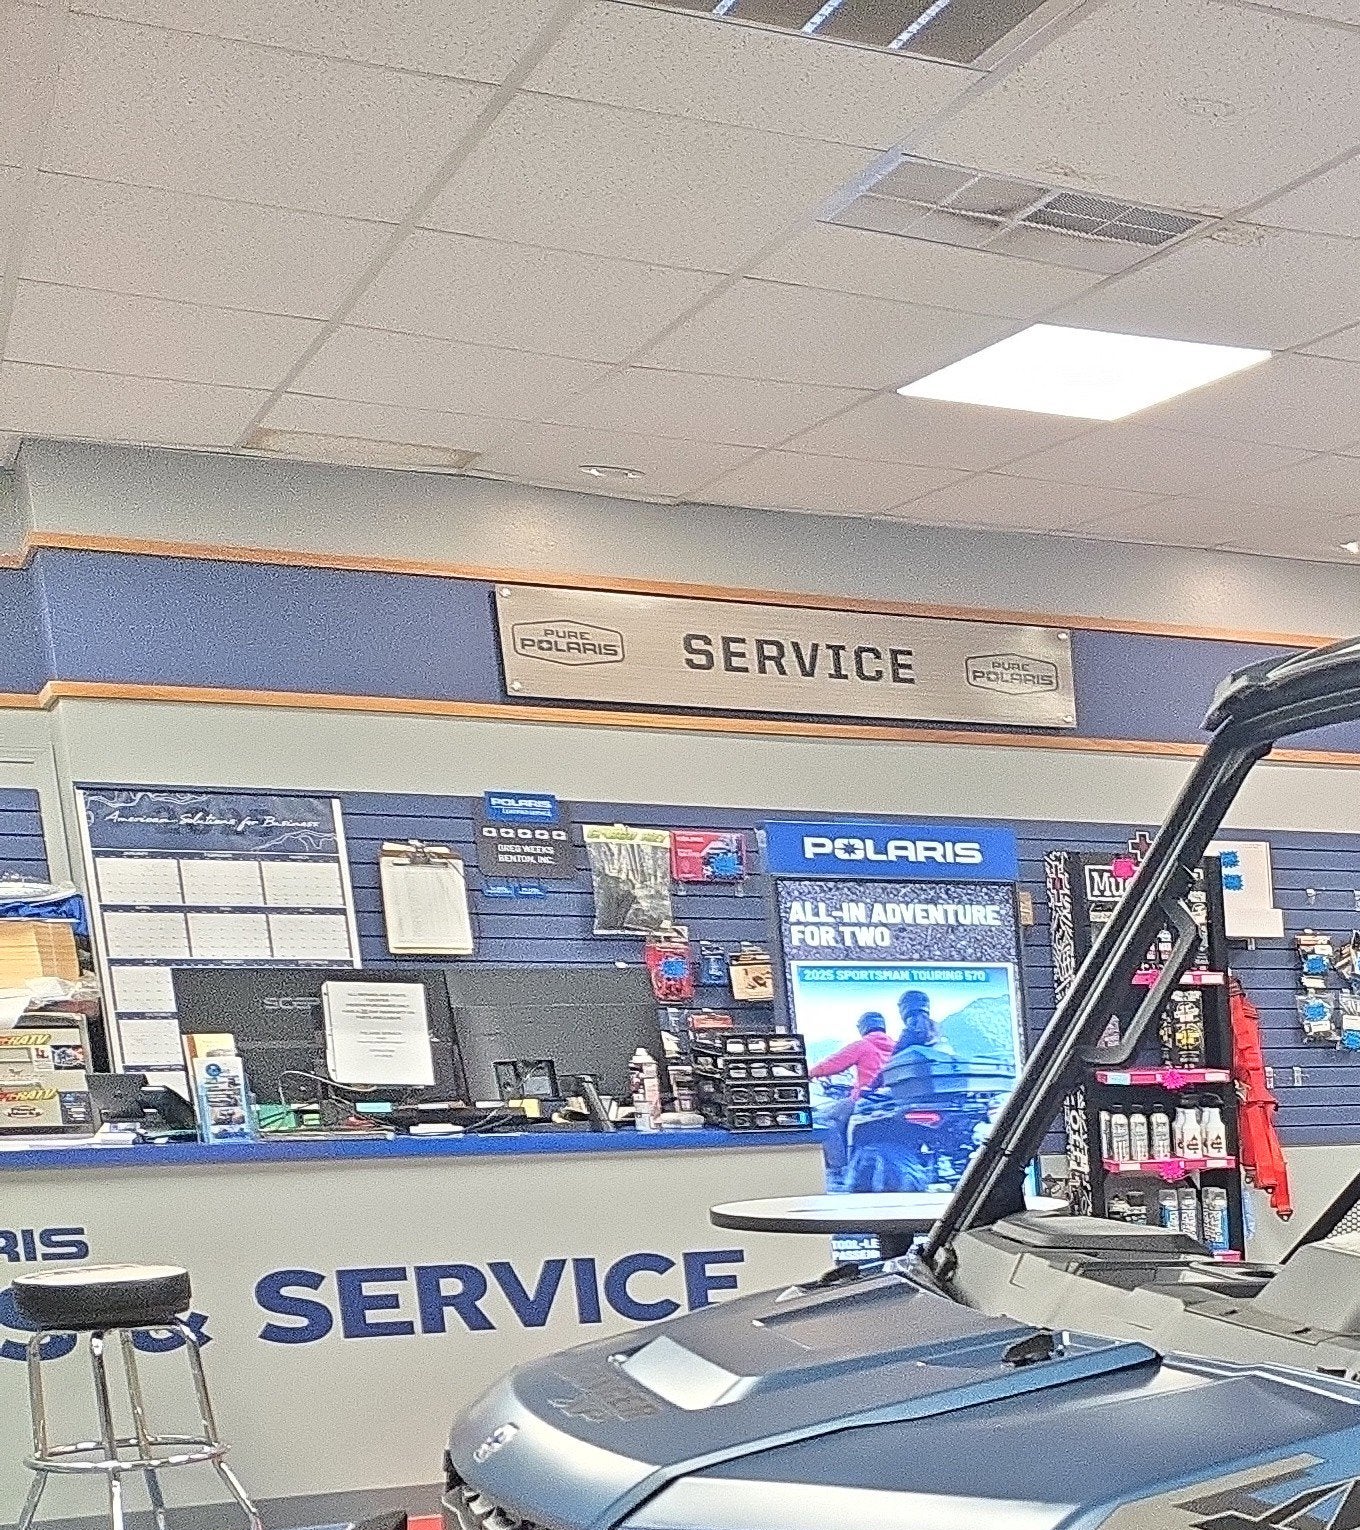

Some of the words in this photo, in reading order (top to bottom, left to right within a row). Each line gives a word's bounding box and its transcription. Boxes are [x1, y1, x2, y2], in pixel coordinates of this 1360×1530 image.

[543, 628, 590, 642] PURE
[520, 636, 619, 658] POLARIS
[682, 633, 917, 686] SERVICE
[991, 660, 1030, 674] PURE
[971, 669, 1054, 689] POLARIS
[803, 836, 983, 864] POLARIS
[1091, 872, 1130, 897] Mu
[789, 901, 867, 923] ALL-IN
[870, 903, 1002, 926] ADVENTURE
[790, 925, 836, 947] FOR
[838, 926, 890, 947] TWO
[802, 969, 835, 981] 2025
[835, 969, 911, 982] SPORTSMAN
[912, 970, 963, 982] TOURING
[0, 1227, 90, 1263] RIS
[254, 1248, 745, 1346] SERVICE
